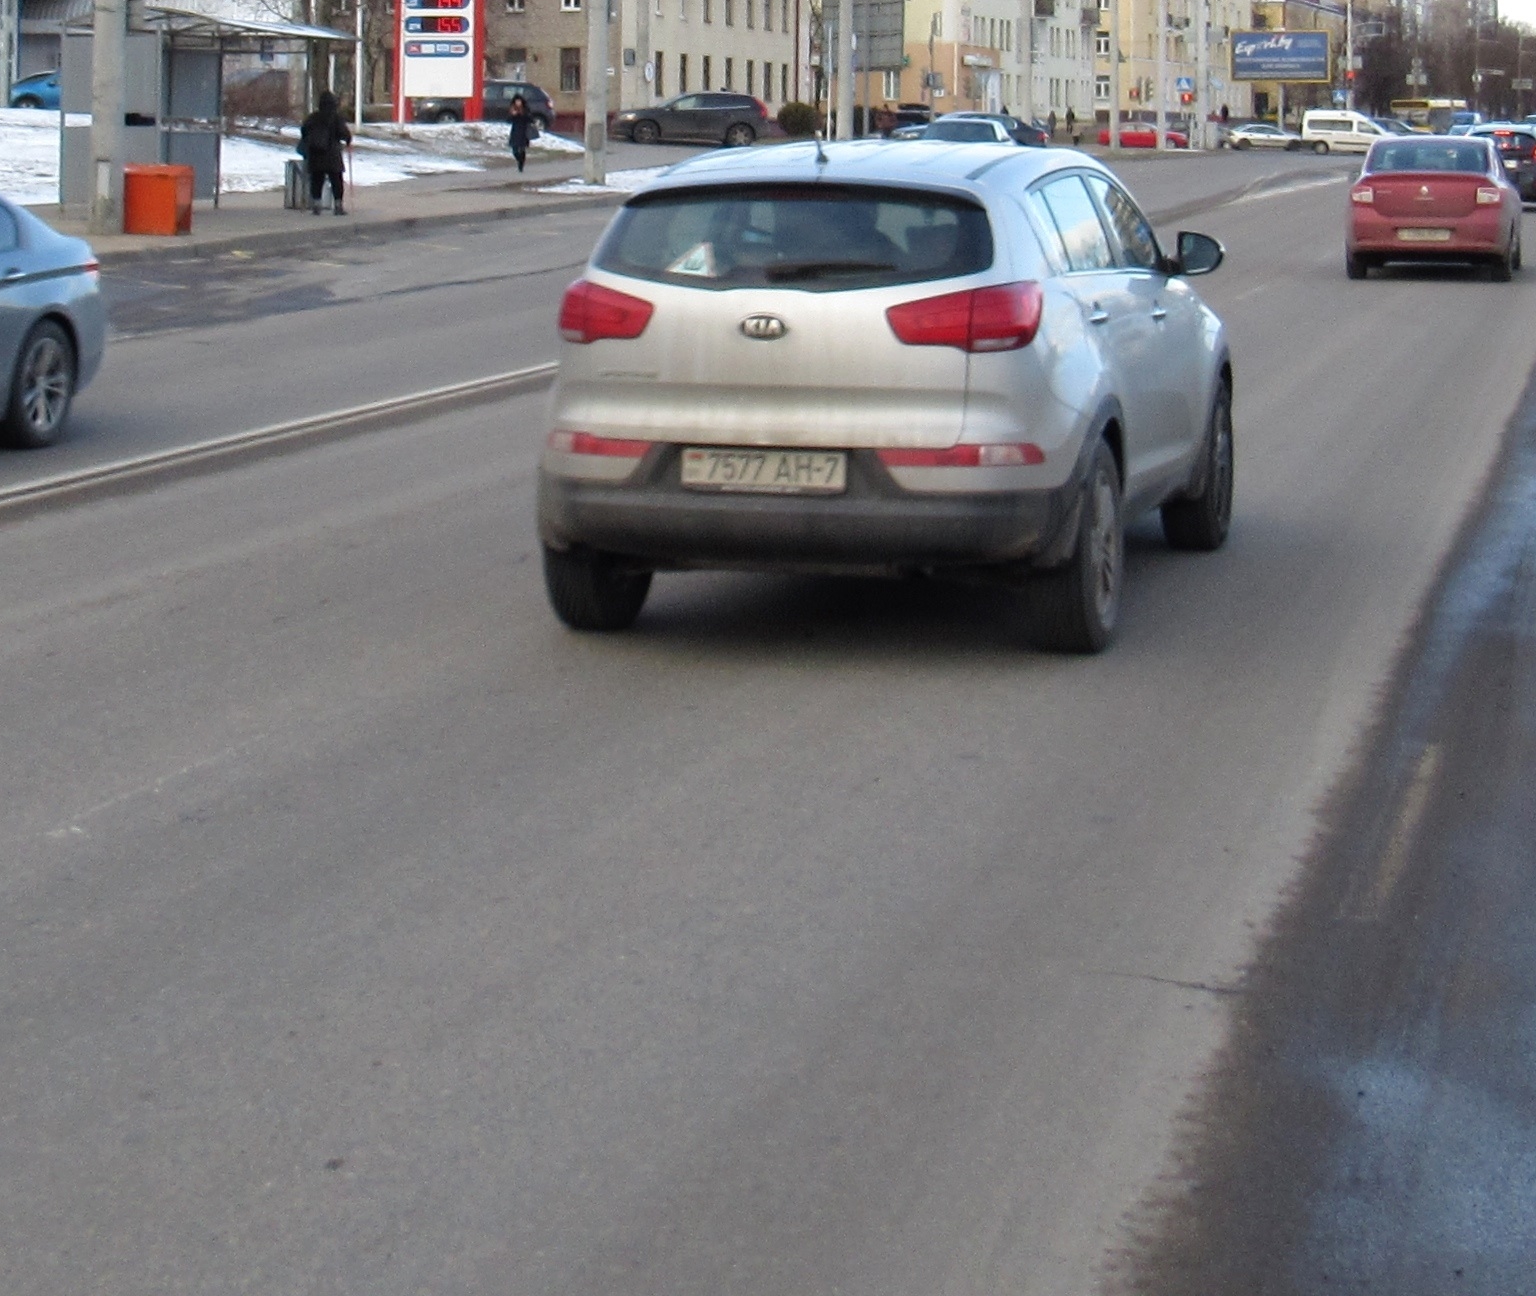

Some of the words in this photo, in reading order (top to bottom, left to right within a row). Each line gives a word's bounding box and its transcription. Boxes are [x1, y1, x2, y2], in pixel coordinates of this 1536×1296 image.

[743, 318, 783, 338] KIA
[707, 450, 766, 480] 7577
[775, 451, 839, 484] AH-7
